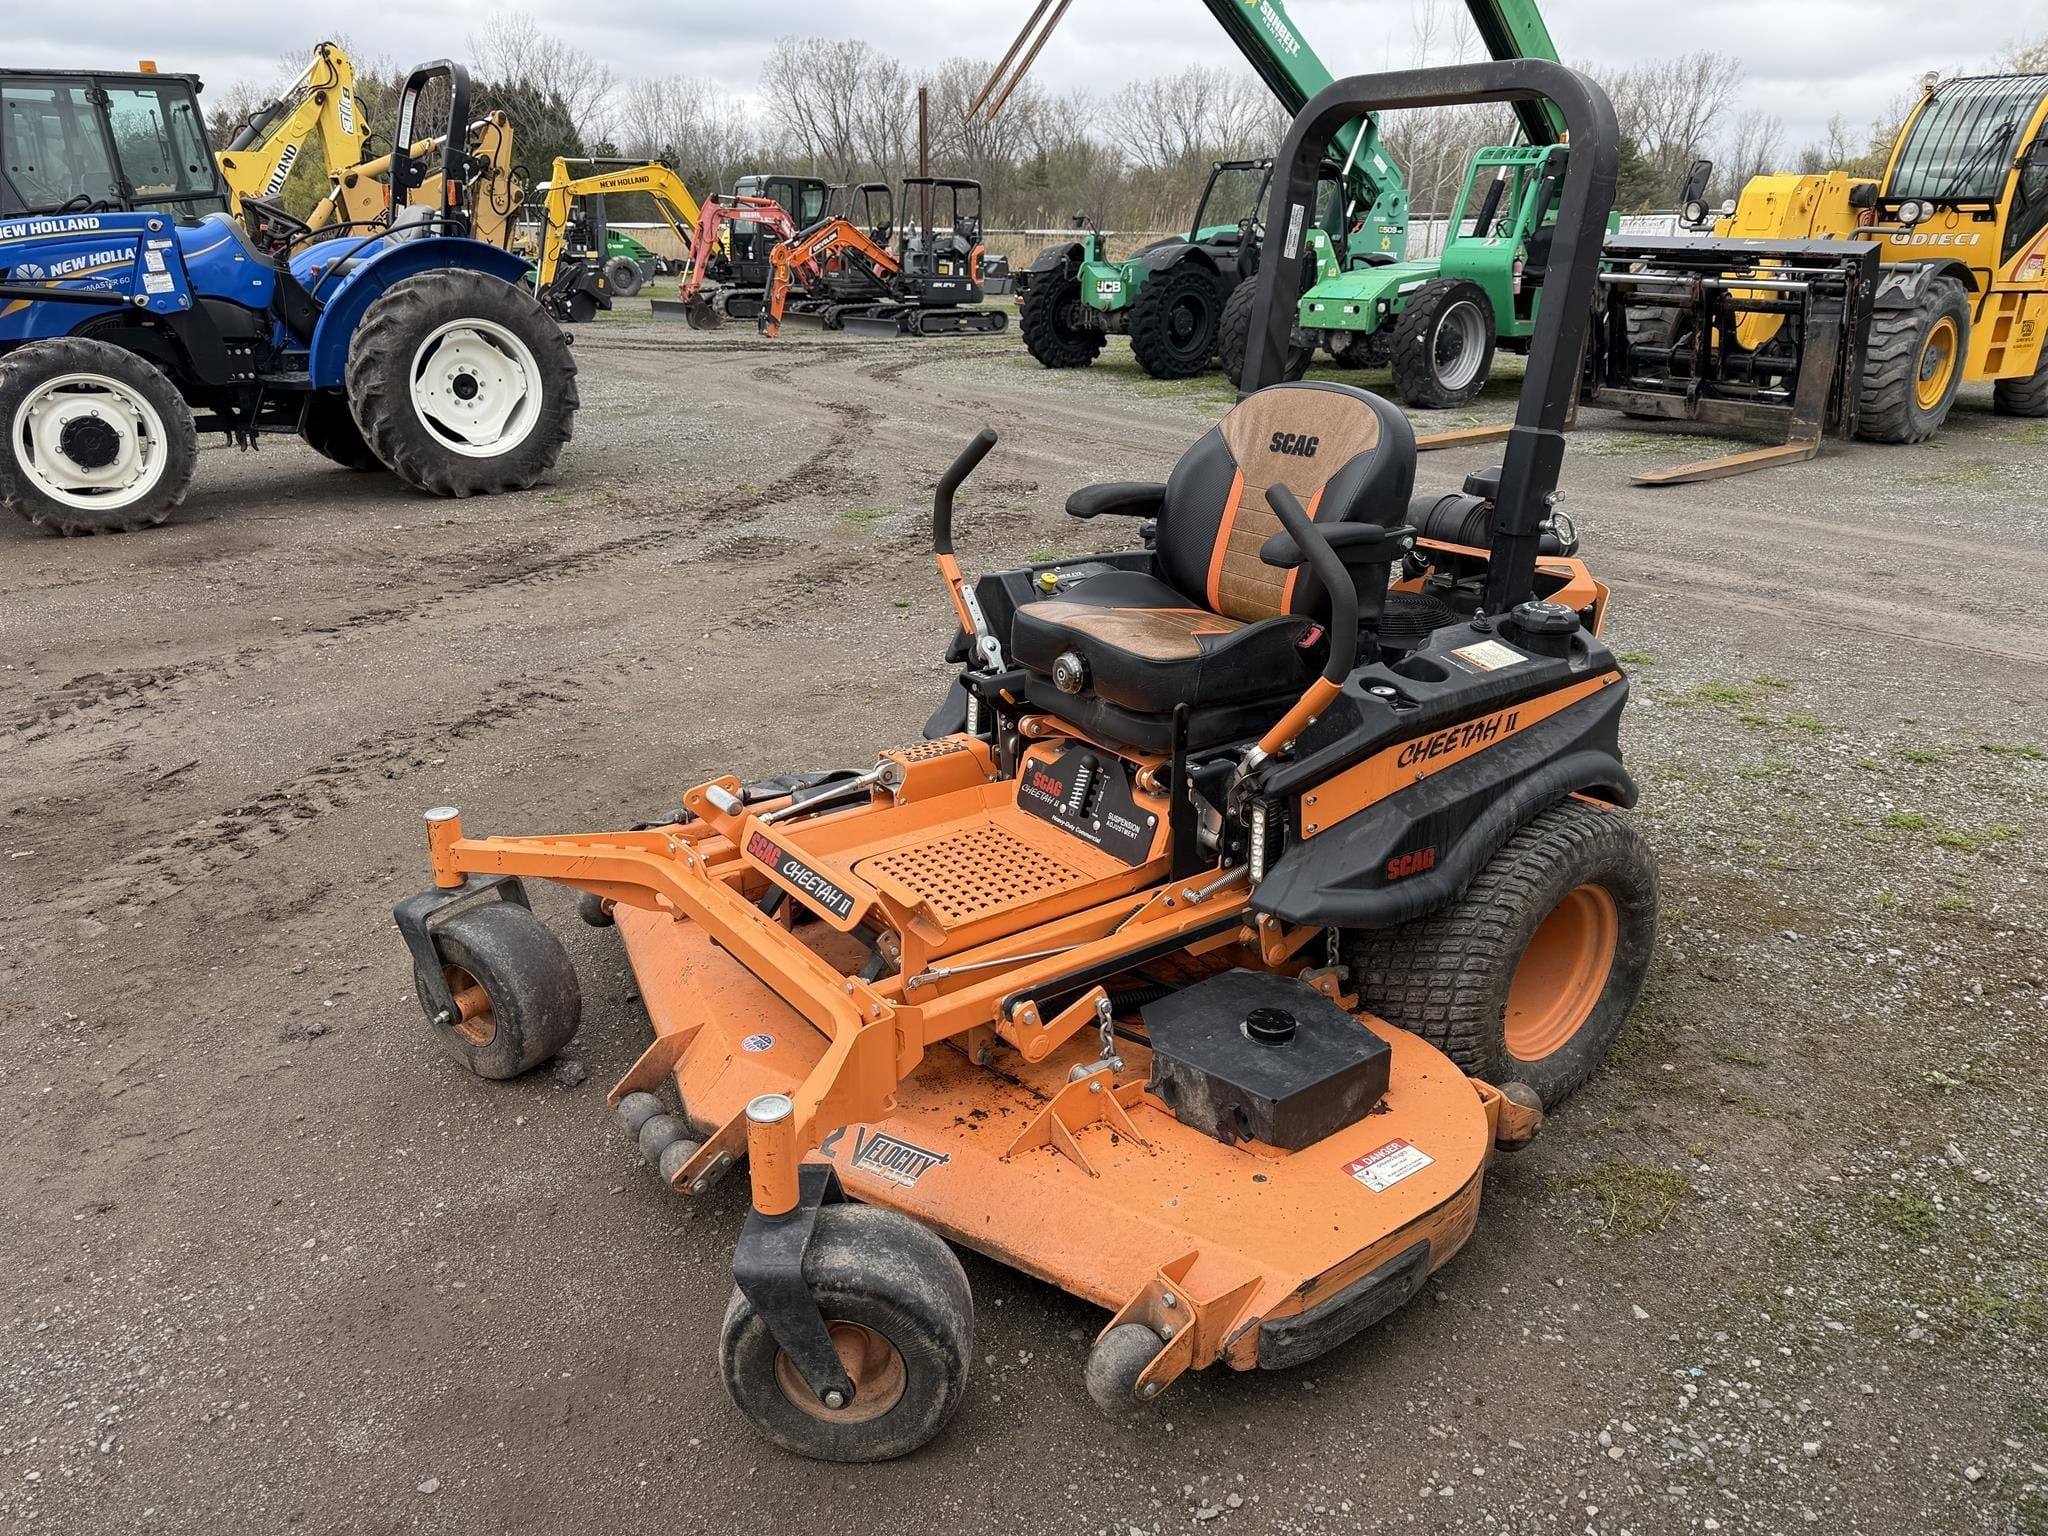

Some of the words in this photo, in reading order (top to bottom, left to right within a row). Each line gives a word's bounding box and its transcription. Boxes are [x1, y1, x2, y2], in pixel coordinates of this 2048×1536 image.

[1260, 0, 1300, 54] SUNBELT
[599, 180, 616, 188] NEW
[617, 175, 650, 186] HOLLAND
[30, 217, 100, 235] HOLLAND
[1910, 233, 1981, 246] DIECI
[50, 258, 86, 276] NEW
[89, 247, 137, 266] HOLLA
[119, 276, 130, 284] 60
[1096, 280, 1121, 293] JCB
[1269, 432, 1320, 457] SCAG
[1397, 714, 1502, 769] CHEETAH
[1503, 711, 1520, 733] II
[1021, 783, 1056, 805] CHEETAH
[1033, 771, 1063, 798] SCAG
[1105, 820, 1138, 840] ADJUSTMENT
[1107, 812, 1141, 834] SUSPENSION
[748, 833, 782, 869] SCAG
[1387, 847, 1436, 881] SCAG
[782, 860, 843, 908] CHEETAH
[837, 898, 852, 915] II
[1363, 1142, 1402, 1164] DANGER
